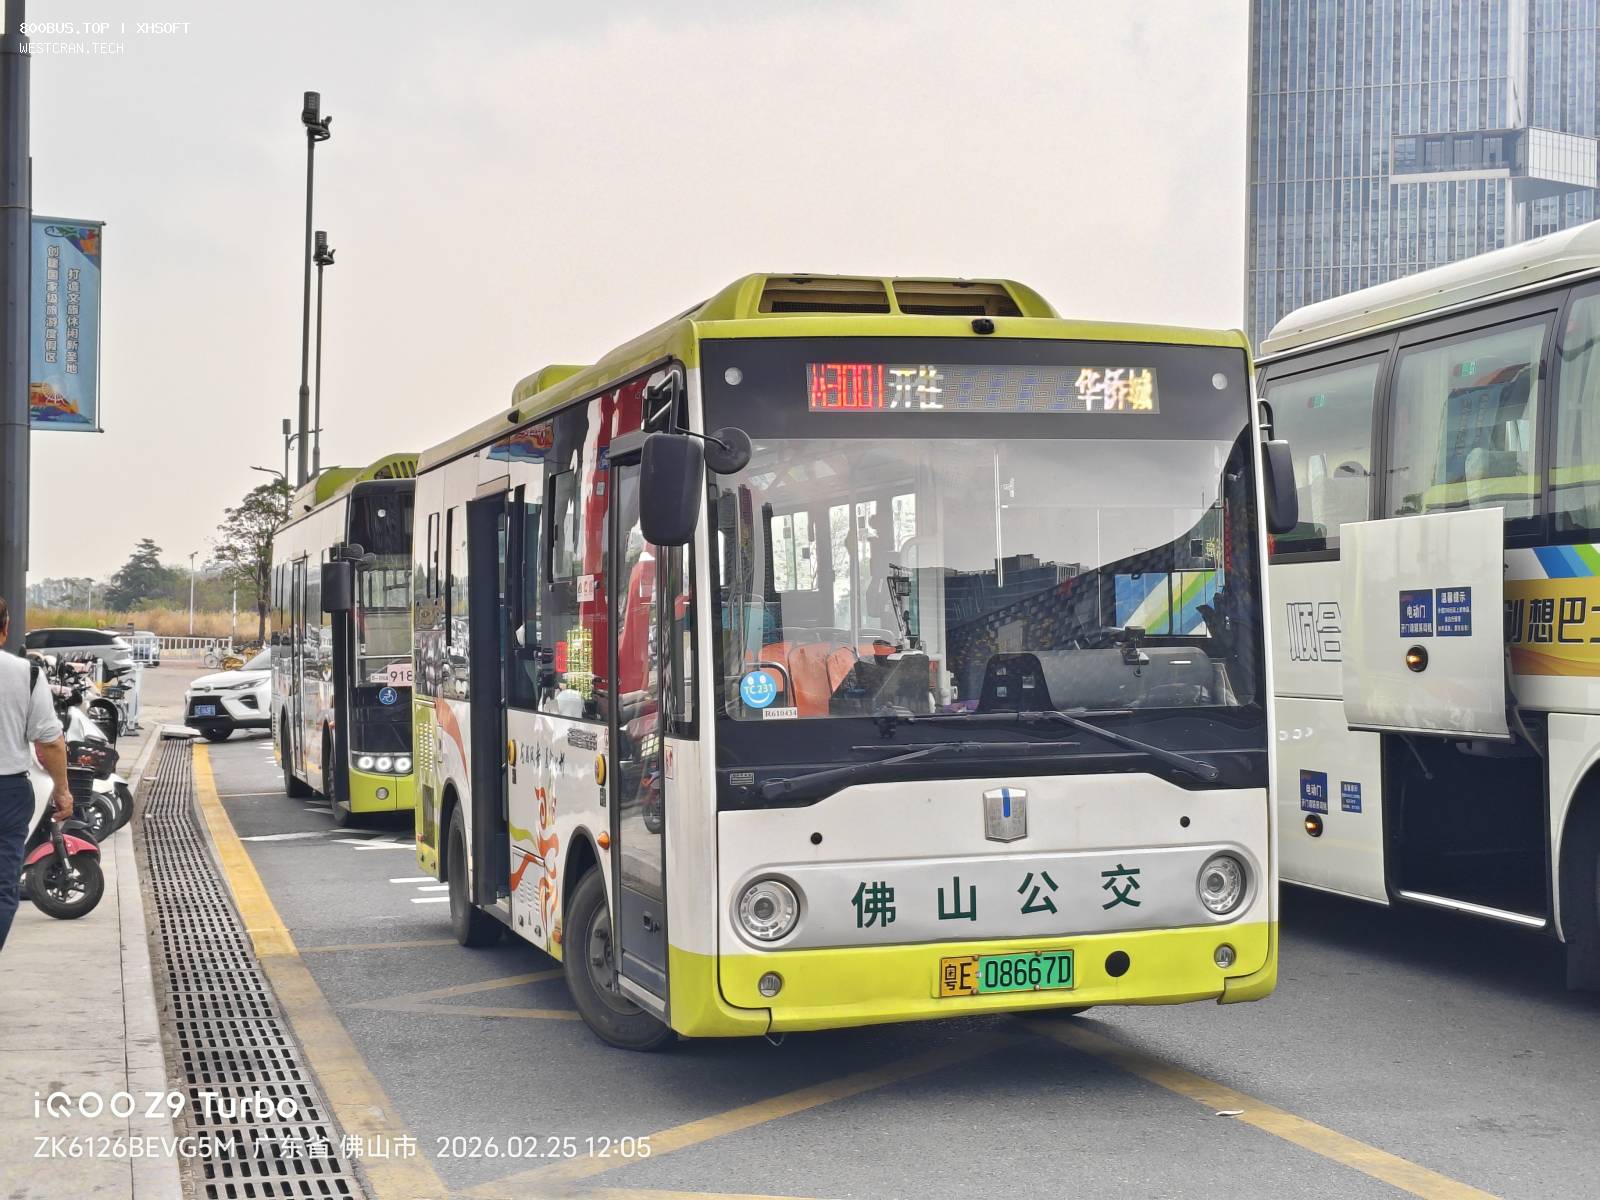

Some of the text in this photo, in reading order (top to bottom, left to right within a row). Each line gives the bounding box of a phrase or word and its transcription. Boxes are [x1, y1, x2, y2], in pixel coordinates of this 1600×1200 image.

[1074, 368, 1153, 411] 华侨城
[1406, 604, 1426, 619] 电动门
[851, 863, 1142, 929] 佛山公交
